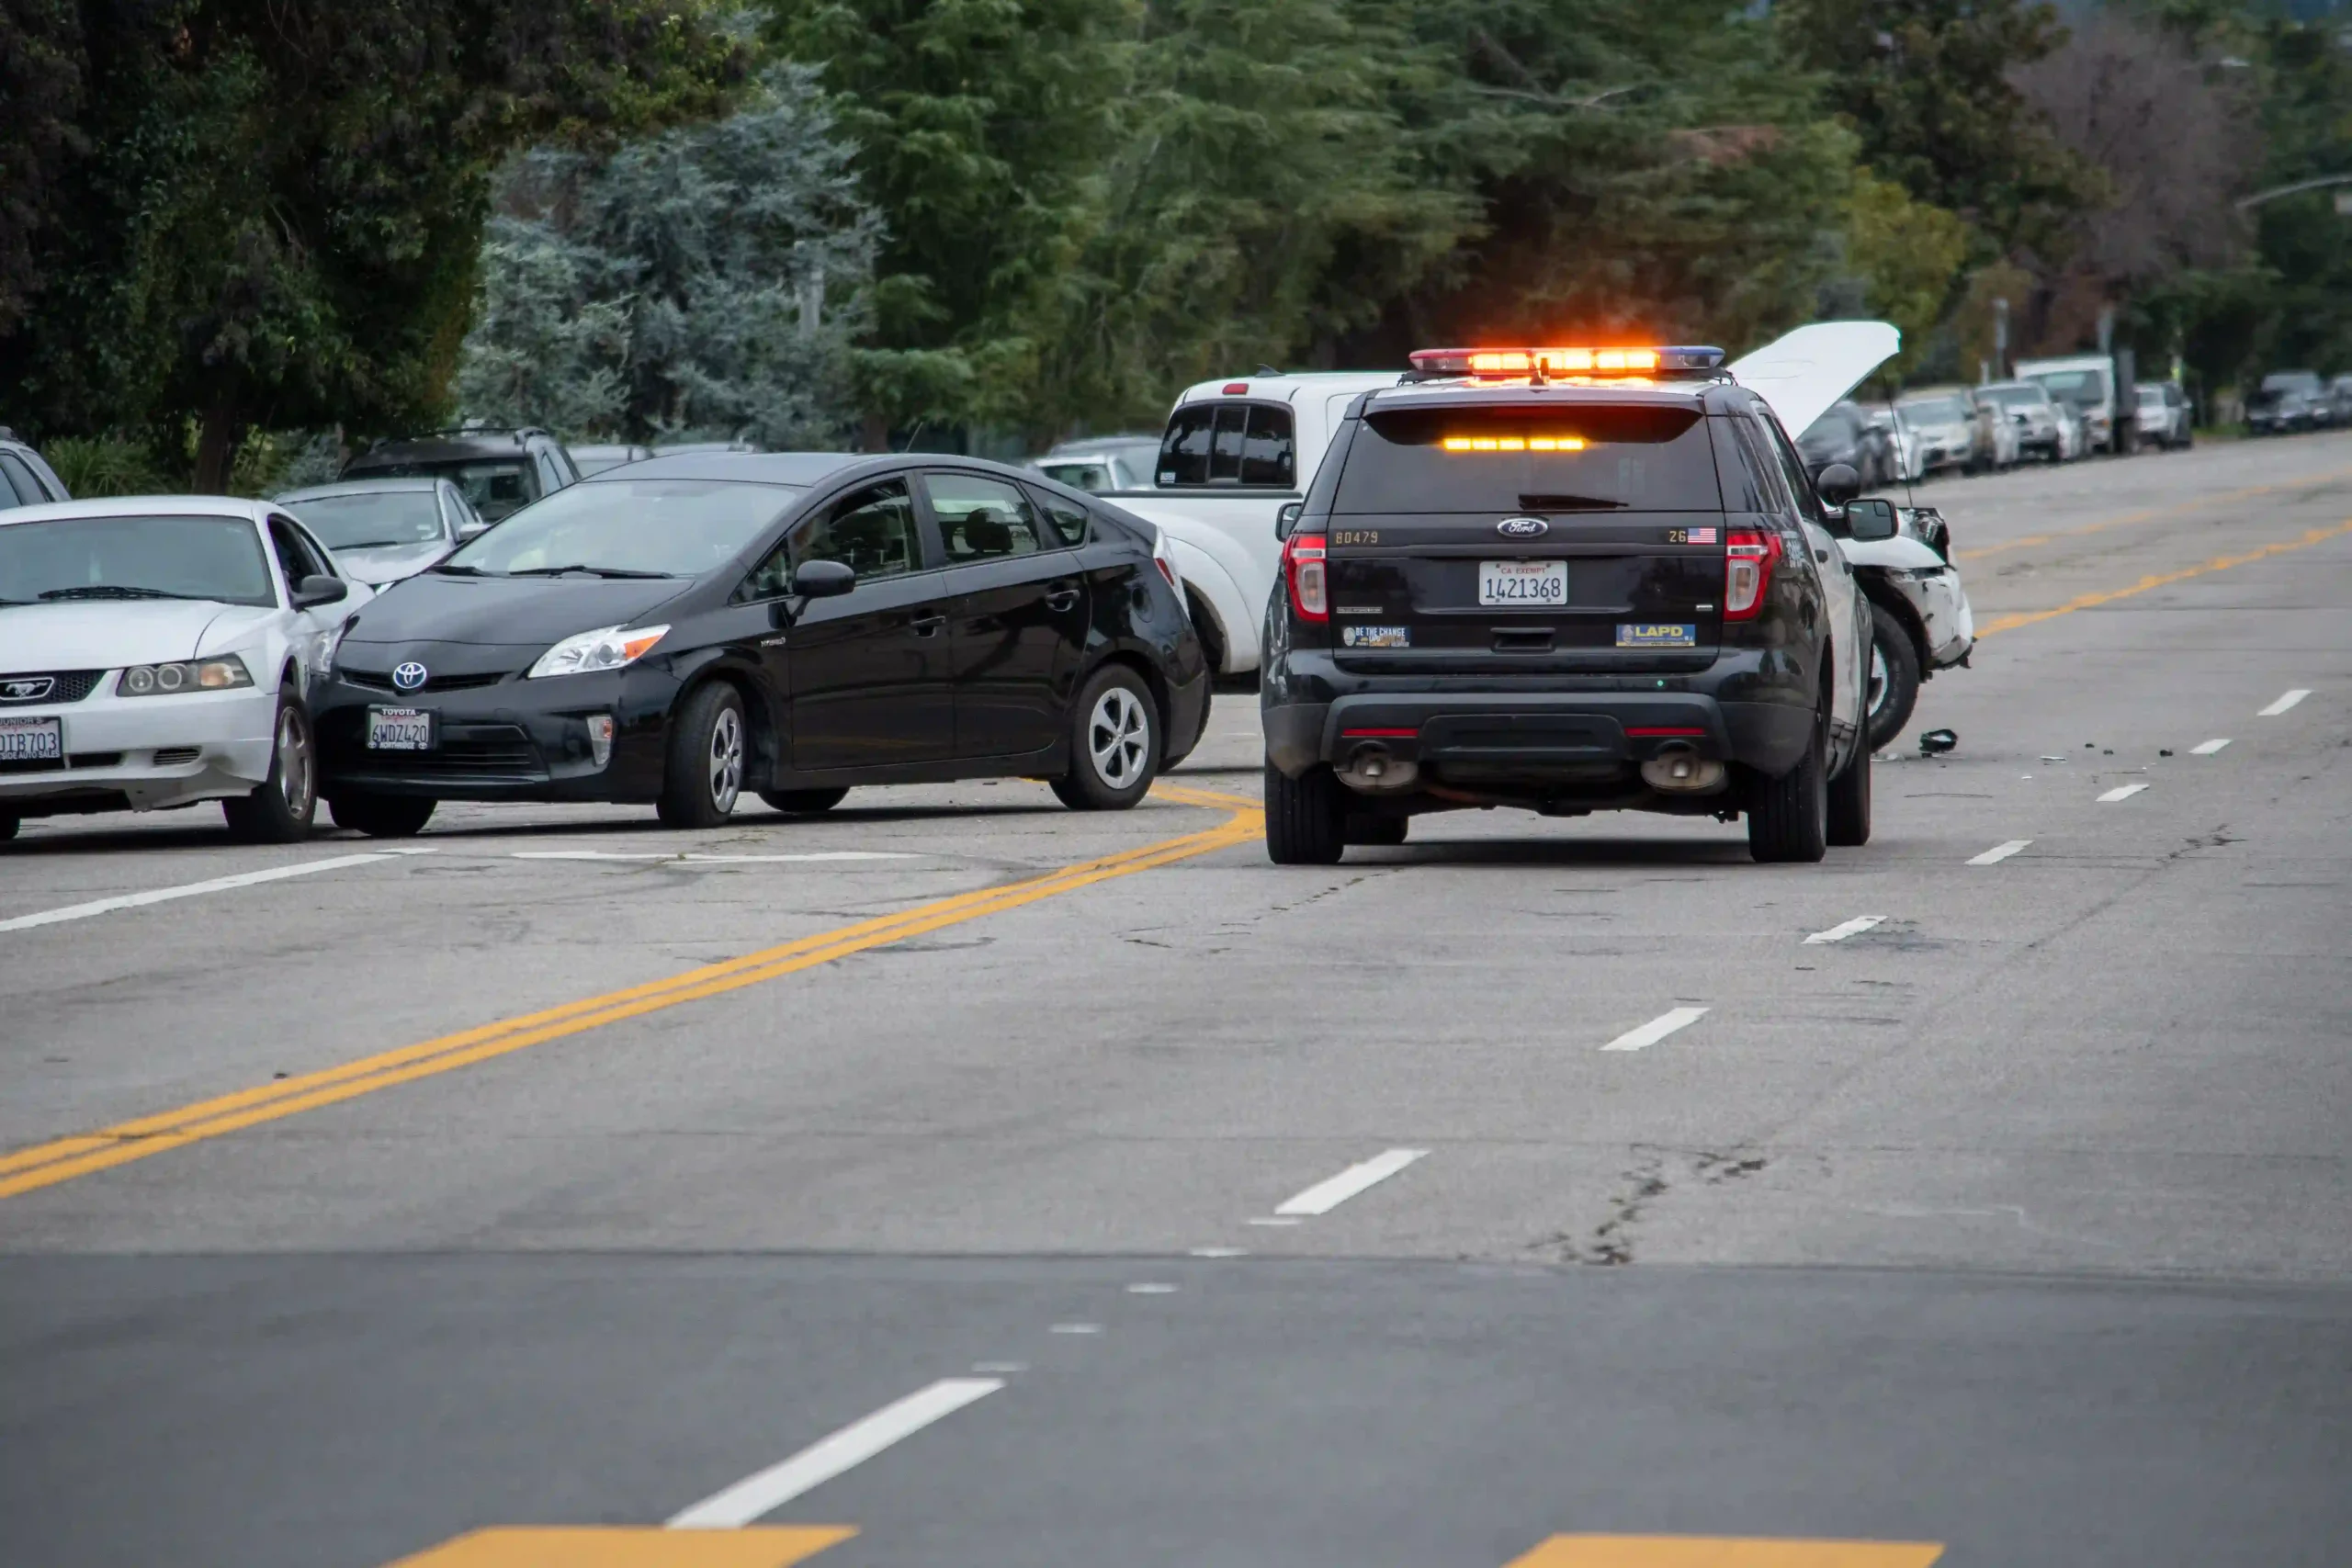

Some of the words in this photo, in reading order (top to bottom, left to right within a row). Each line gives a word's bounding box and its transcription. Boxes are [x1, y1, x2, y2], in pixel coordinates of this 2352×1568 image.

[1509, 521, 1536, 533] Ford
[1336, 531, 1378, 544] 80479
[1669, 530, 1687, 543] 26
[1486, 577, 1561, 599] 1421368
[1355, 627, 1364, 636] BE
[1366, 627, 1378, 637] THE
[1379, 627, 1406, 636] CHANGE
[1635, 626, 1683, 637] LAPD
[372, 724, 427, 743] 6WDZ420
[19, 751, 38, 760] AUTO
